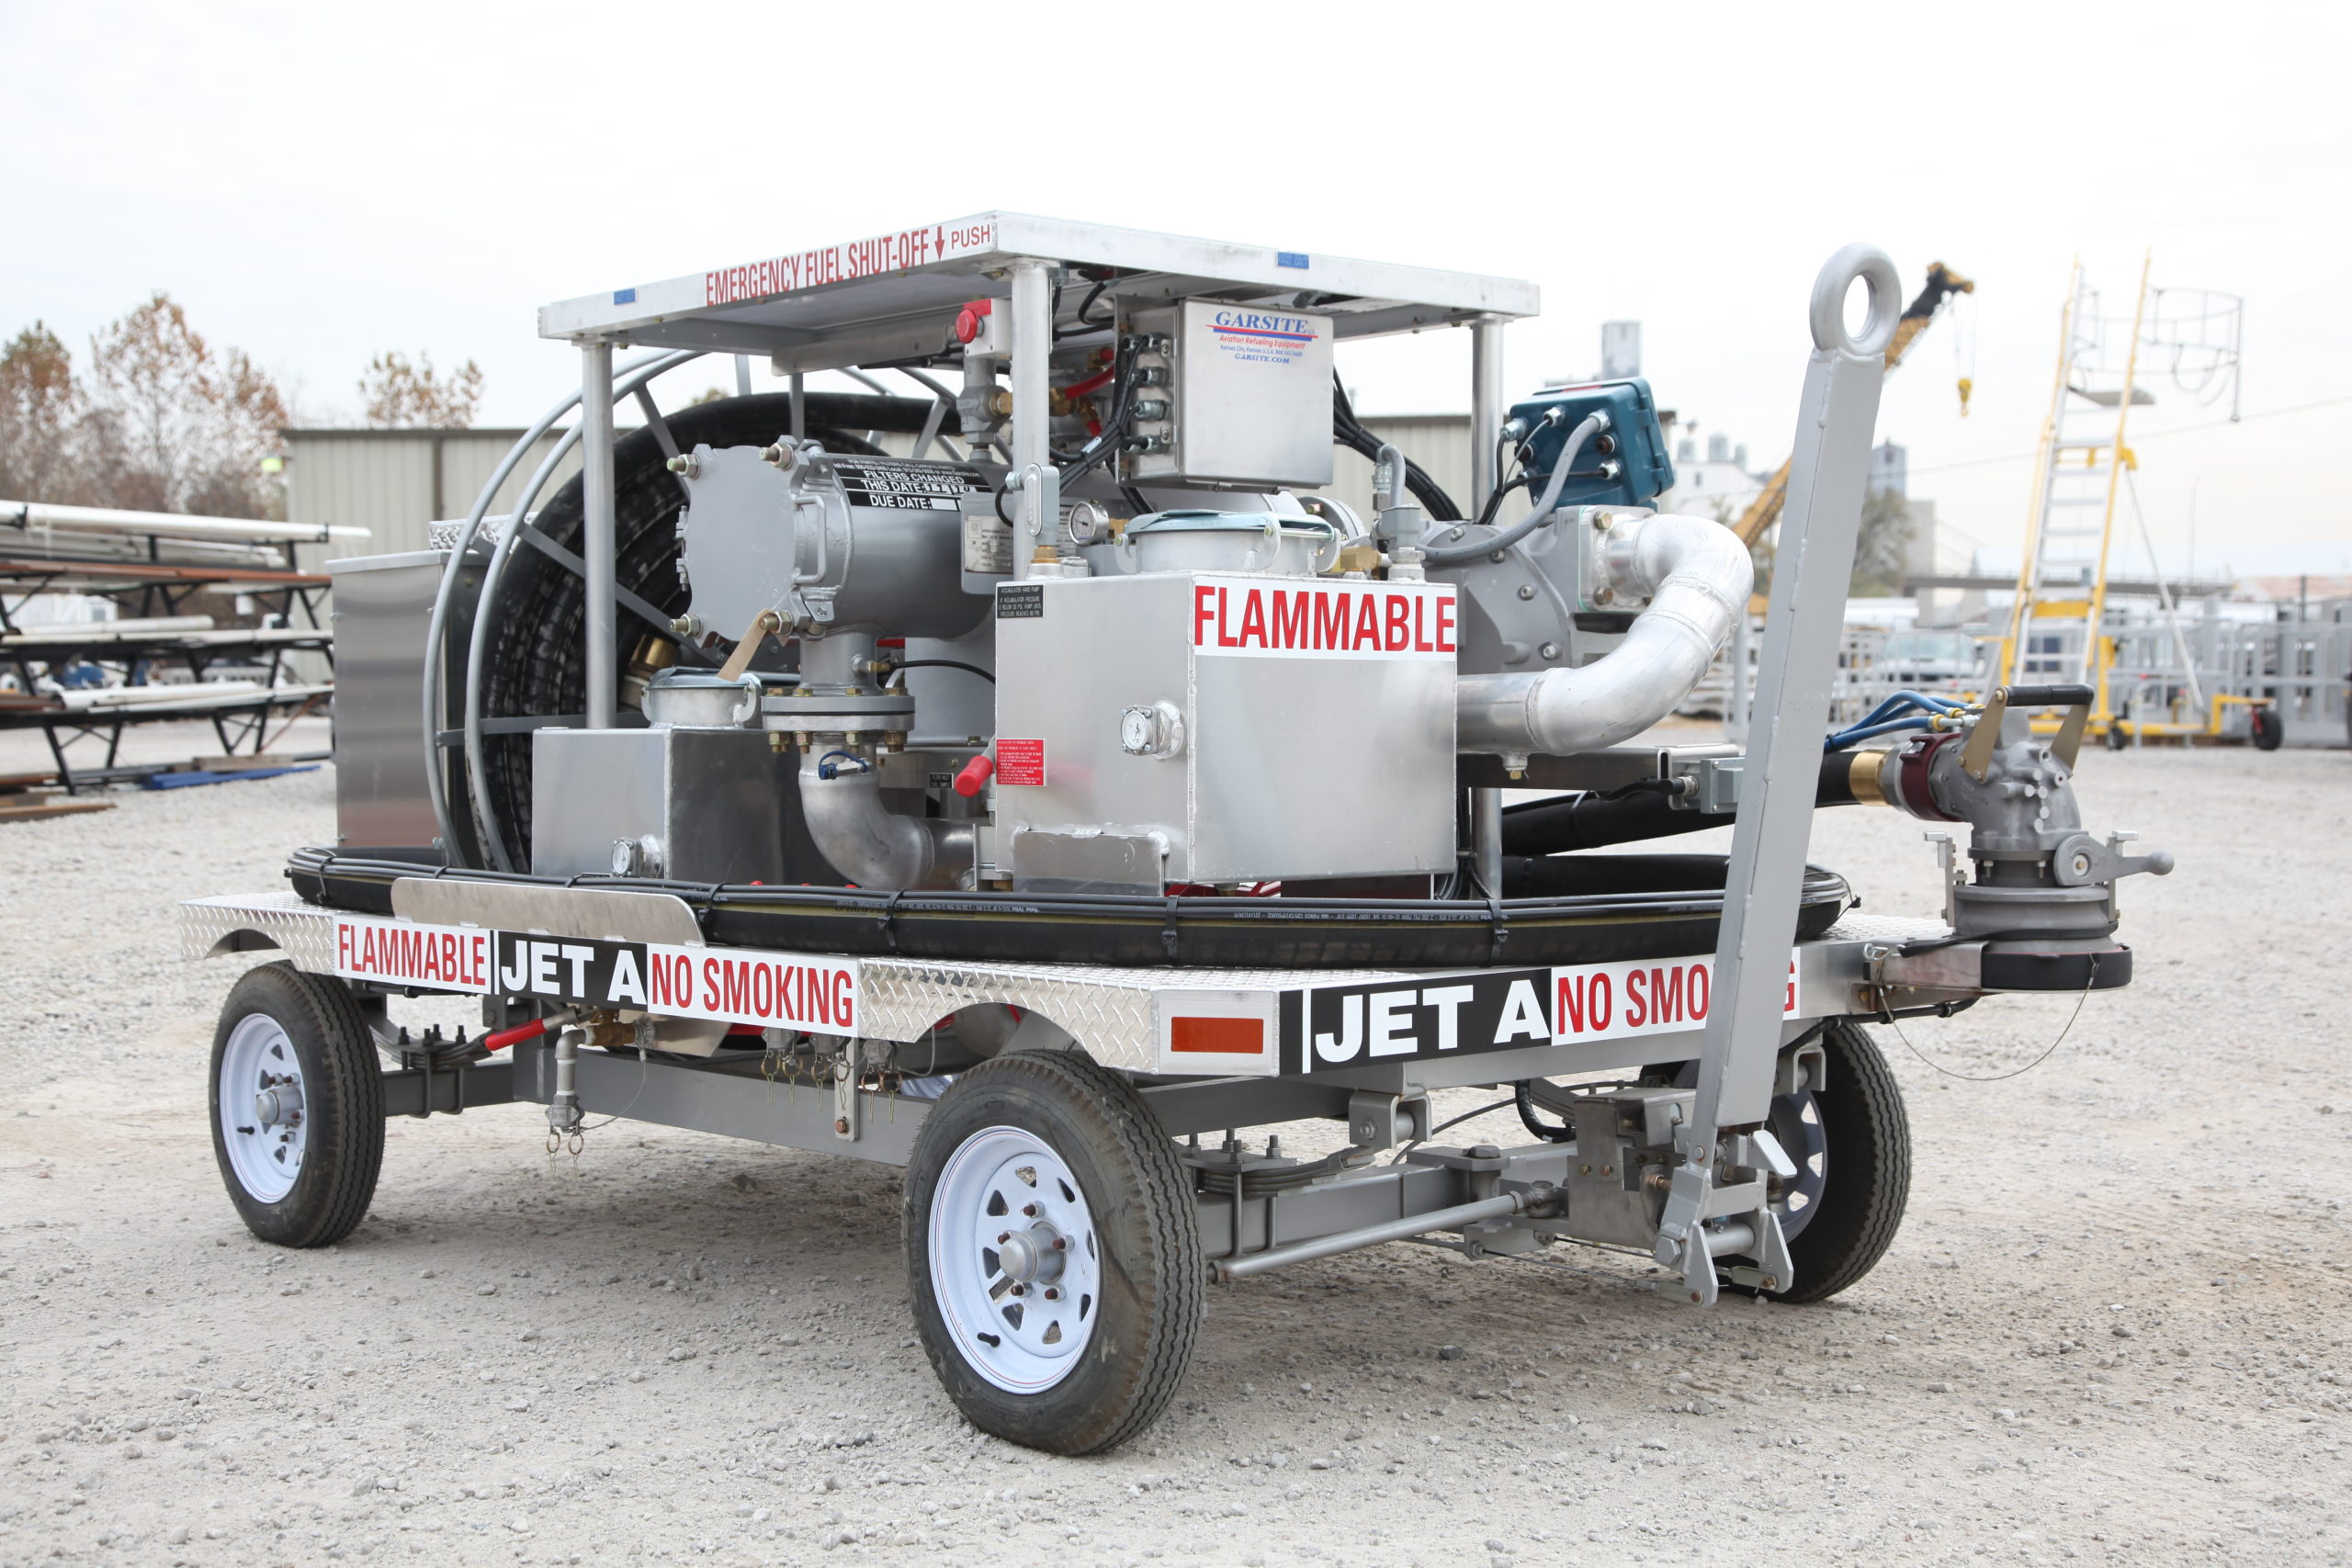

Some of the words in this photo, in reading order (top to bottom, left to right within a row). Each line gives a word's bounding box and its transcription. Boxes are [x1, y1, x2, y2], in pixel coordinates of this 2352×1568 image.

[951, 224, 991, 249] PUSH
[707, 255, 800, 306] EMERGENCY
[806, 248, 843, 288] FUEL
[849, 228, 929, 278] SHUT-OFF
[1216, 311, 1308, 333] GARSITE
[1246, 337, 1272, 347] Refueling
[1274, 339, 1305, 349] Equipment
[1235, 353, 1290, 364] GARSITE.COM
[861, 479, 889, 491] THIS
[891, 481, 928, 493] DATE:
[863, 469, 910, 480] FILTERS
[910, 473, 965, 484] CHANGED
[869, 494, 895, 507] DUE
[897, 496, 933, 509] DATE:
[1194, 585, 1455, 652] FLAMMABLE
[339, 924, 486, 986] FLAMMABLE
[501, 941, 594, 998] JET
[607, 949, 645, 1005] A
[651, 953, 692, 1009] NO
[703, 957, 853, 1027] SMOKING
[1558, 972, 1611, 1035] NO
[1315, 985, 1473, 1063] JET
[1493, 979, 1551, 1043] A
